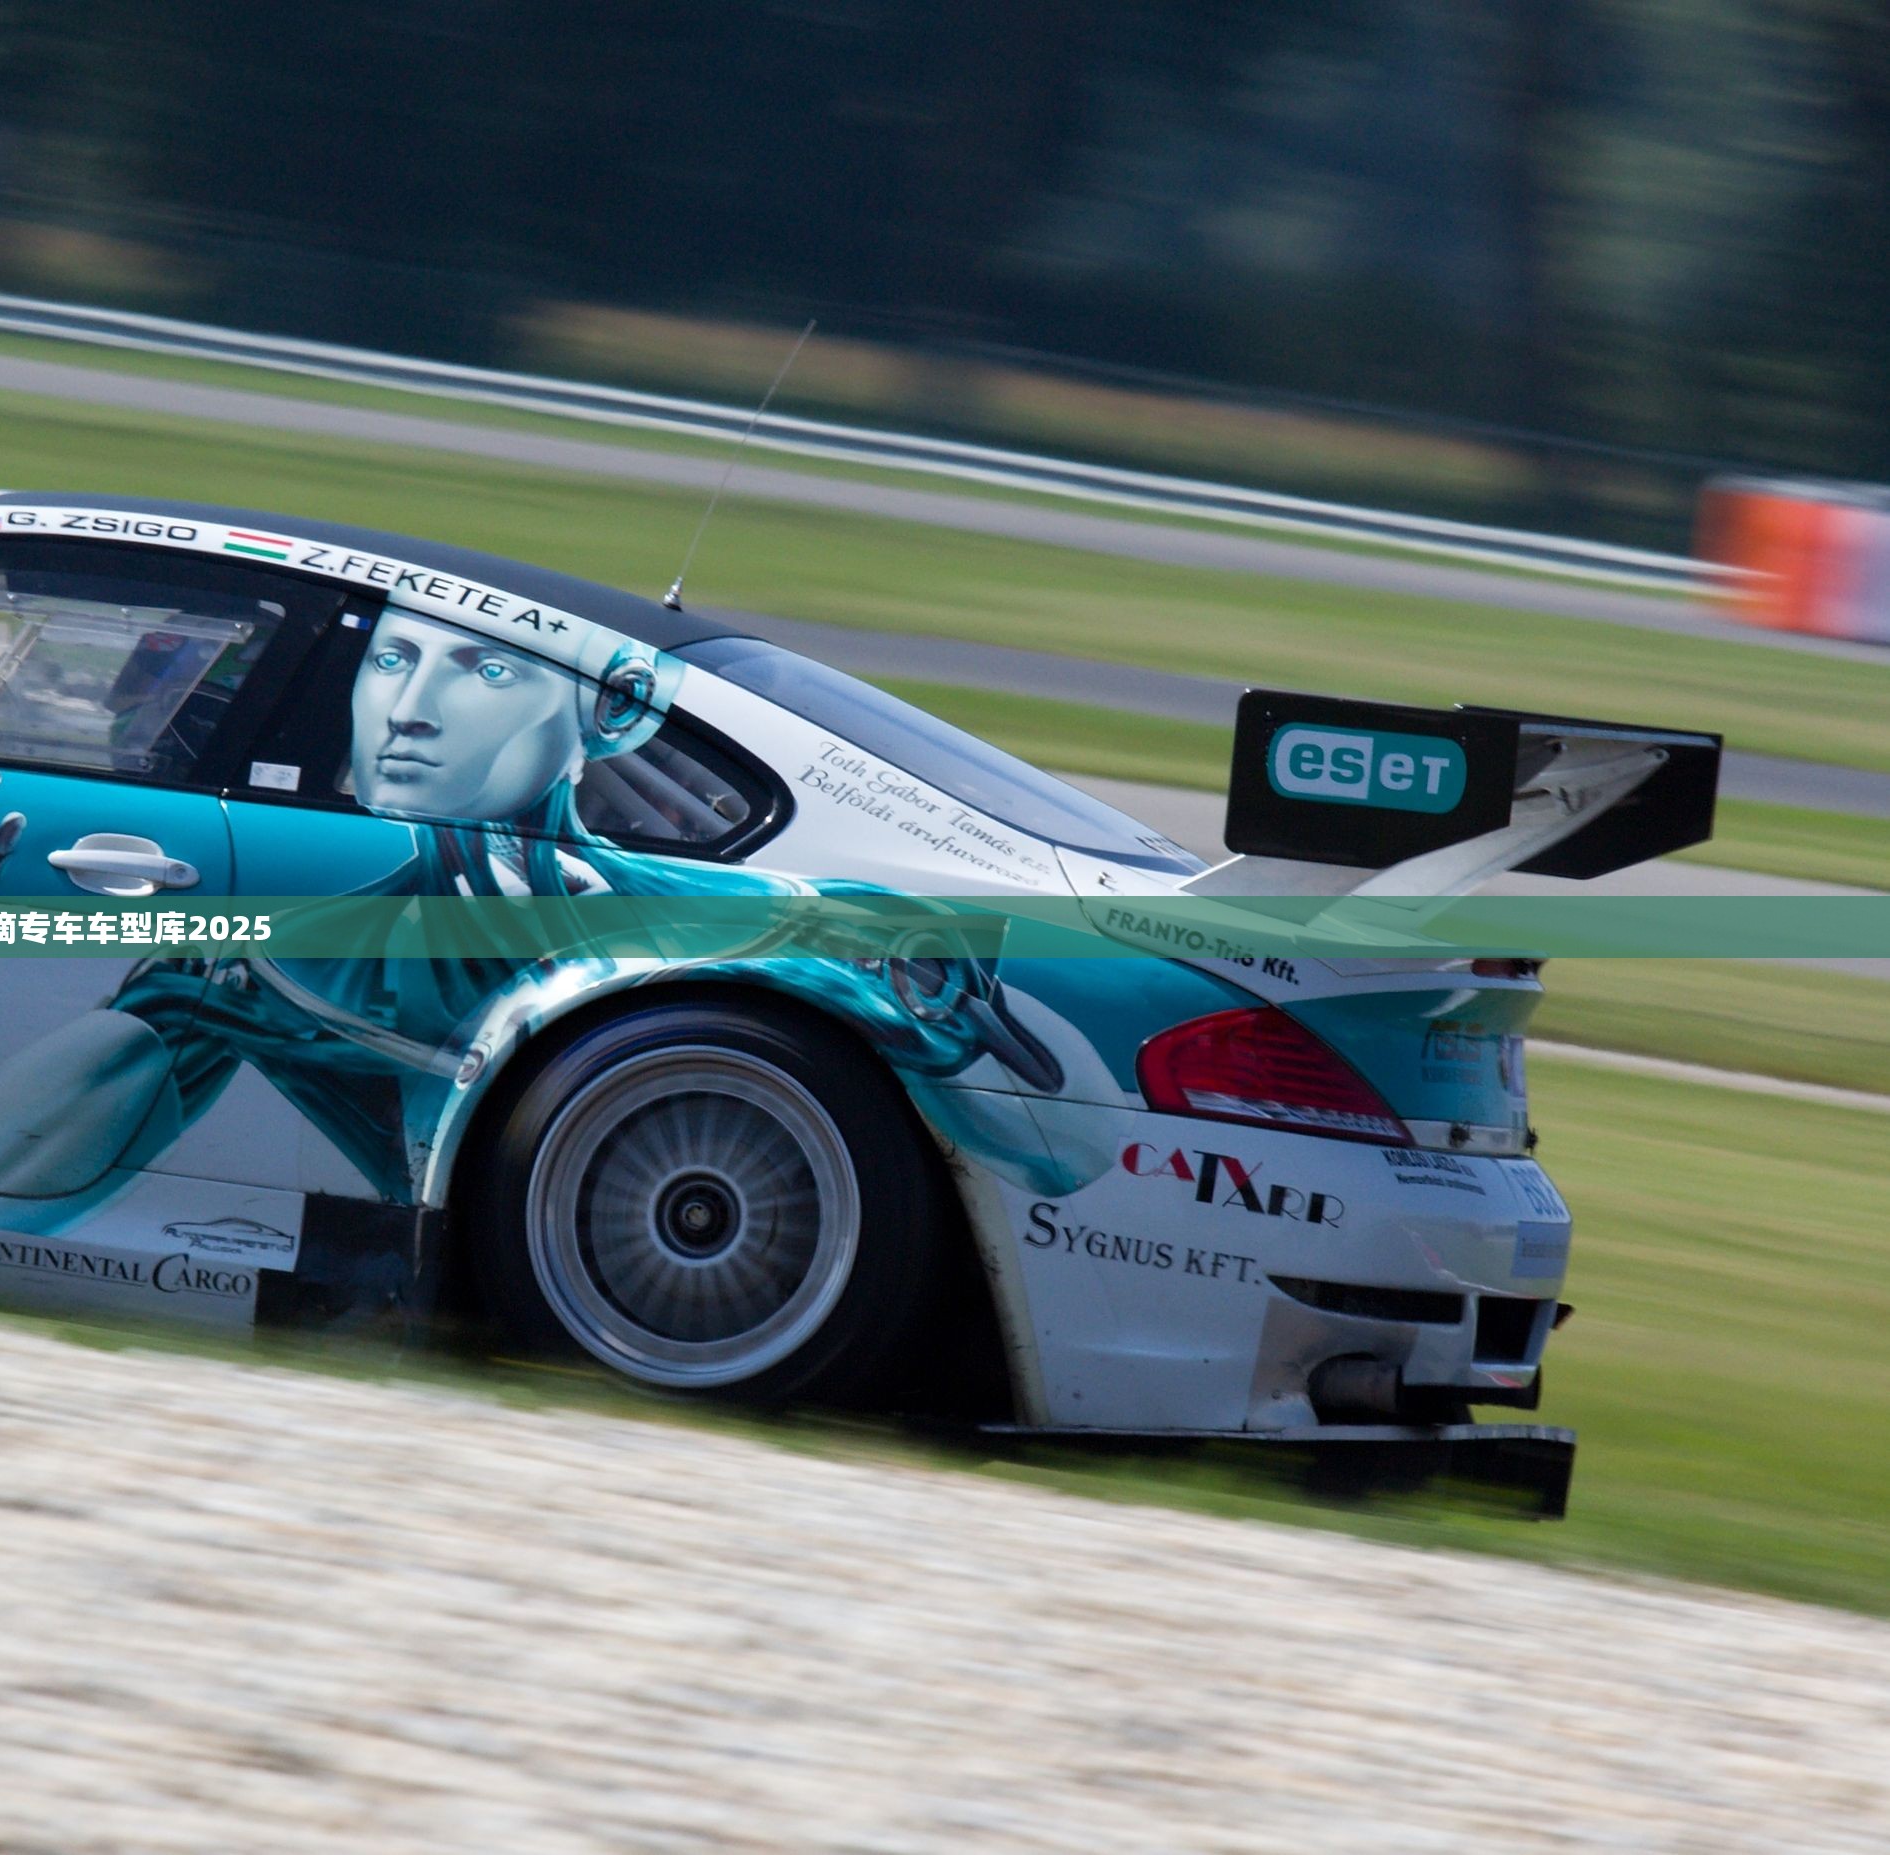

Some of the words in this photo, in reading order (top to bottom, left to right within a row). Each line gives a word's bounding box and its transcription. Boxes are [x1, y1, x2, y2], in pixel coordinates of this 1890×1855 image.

[6, 510, 48, 528] G.
[61, 514, 199, 541] ZSIGO
[298, 546, 512, 618] Z.FEKETE
[511, 608, 570, 634] A+
[1261, 957, 1300, 986] Kft.
[1022, 1201, 1174, 1270] SYGNUS
[1183, 1246, 1262, 1285] KFT.
[151, 1252, 252, 1295] CARGO
